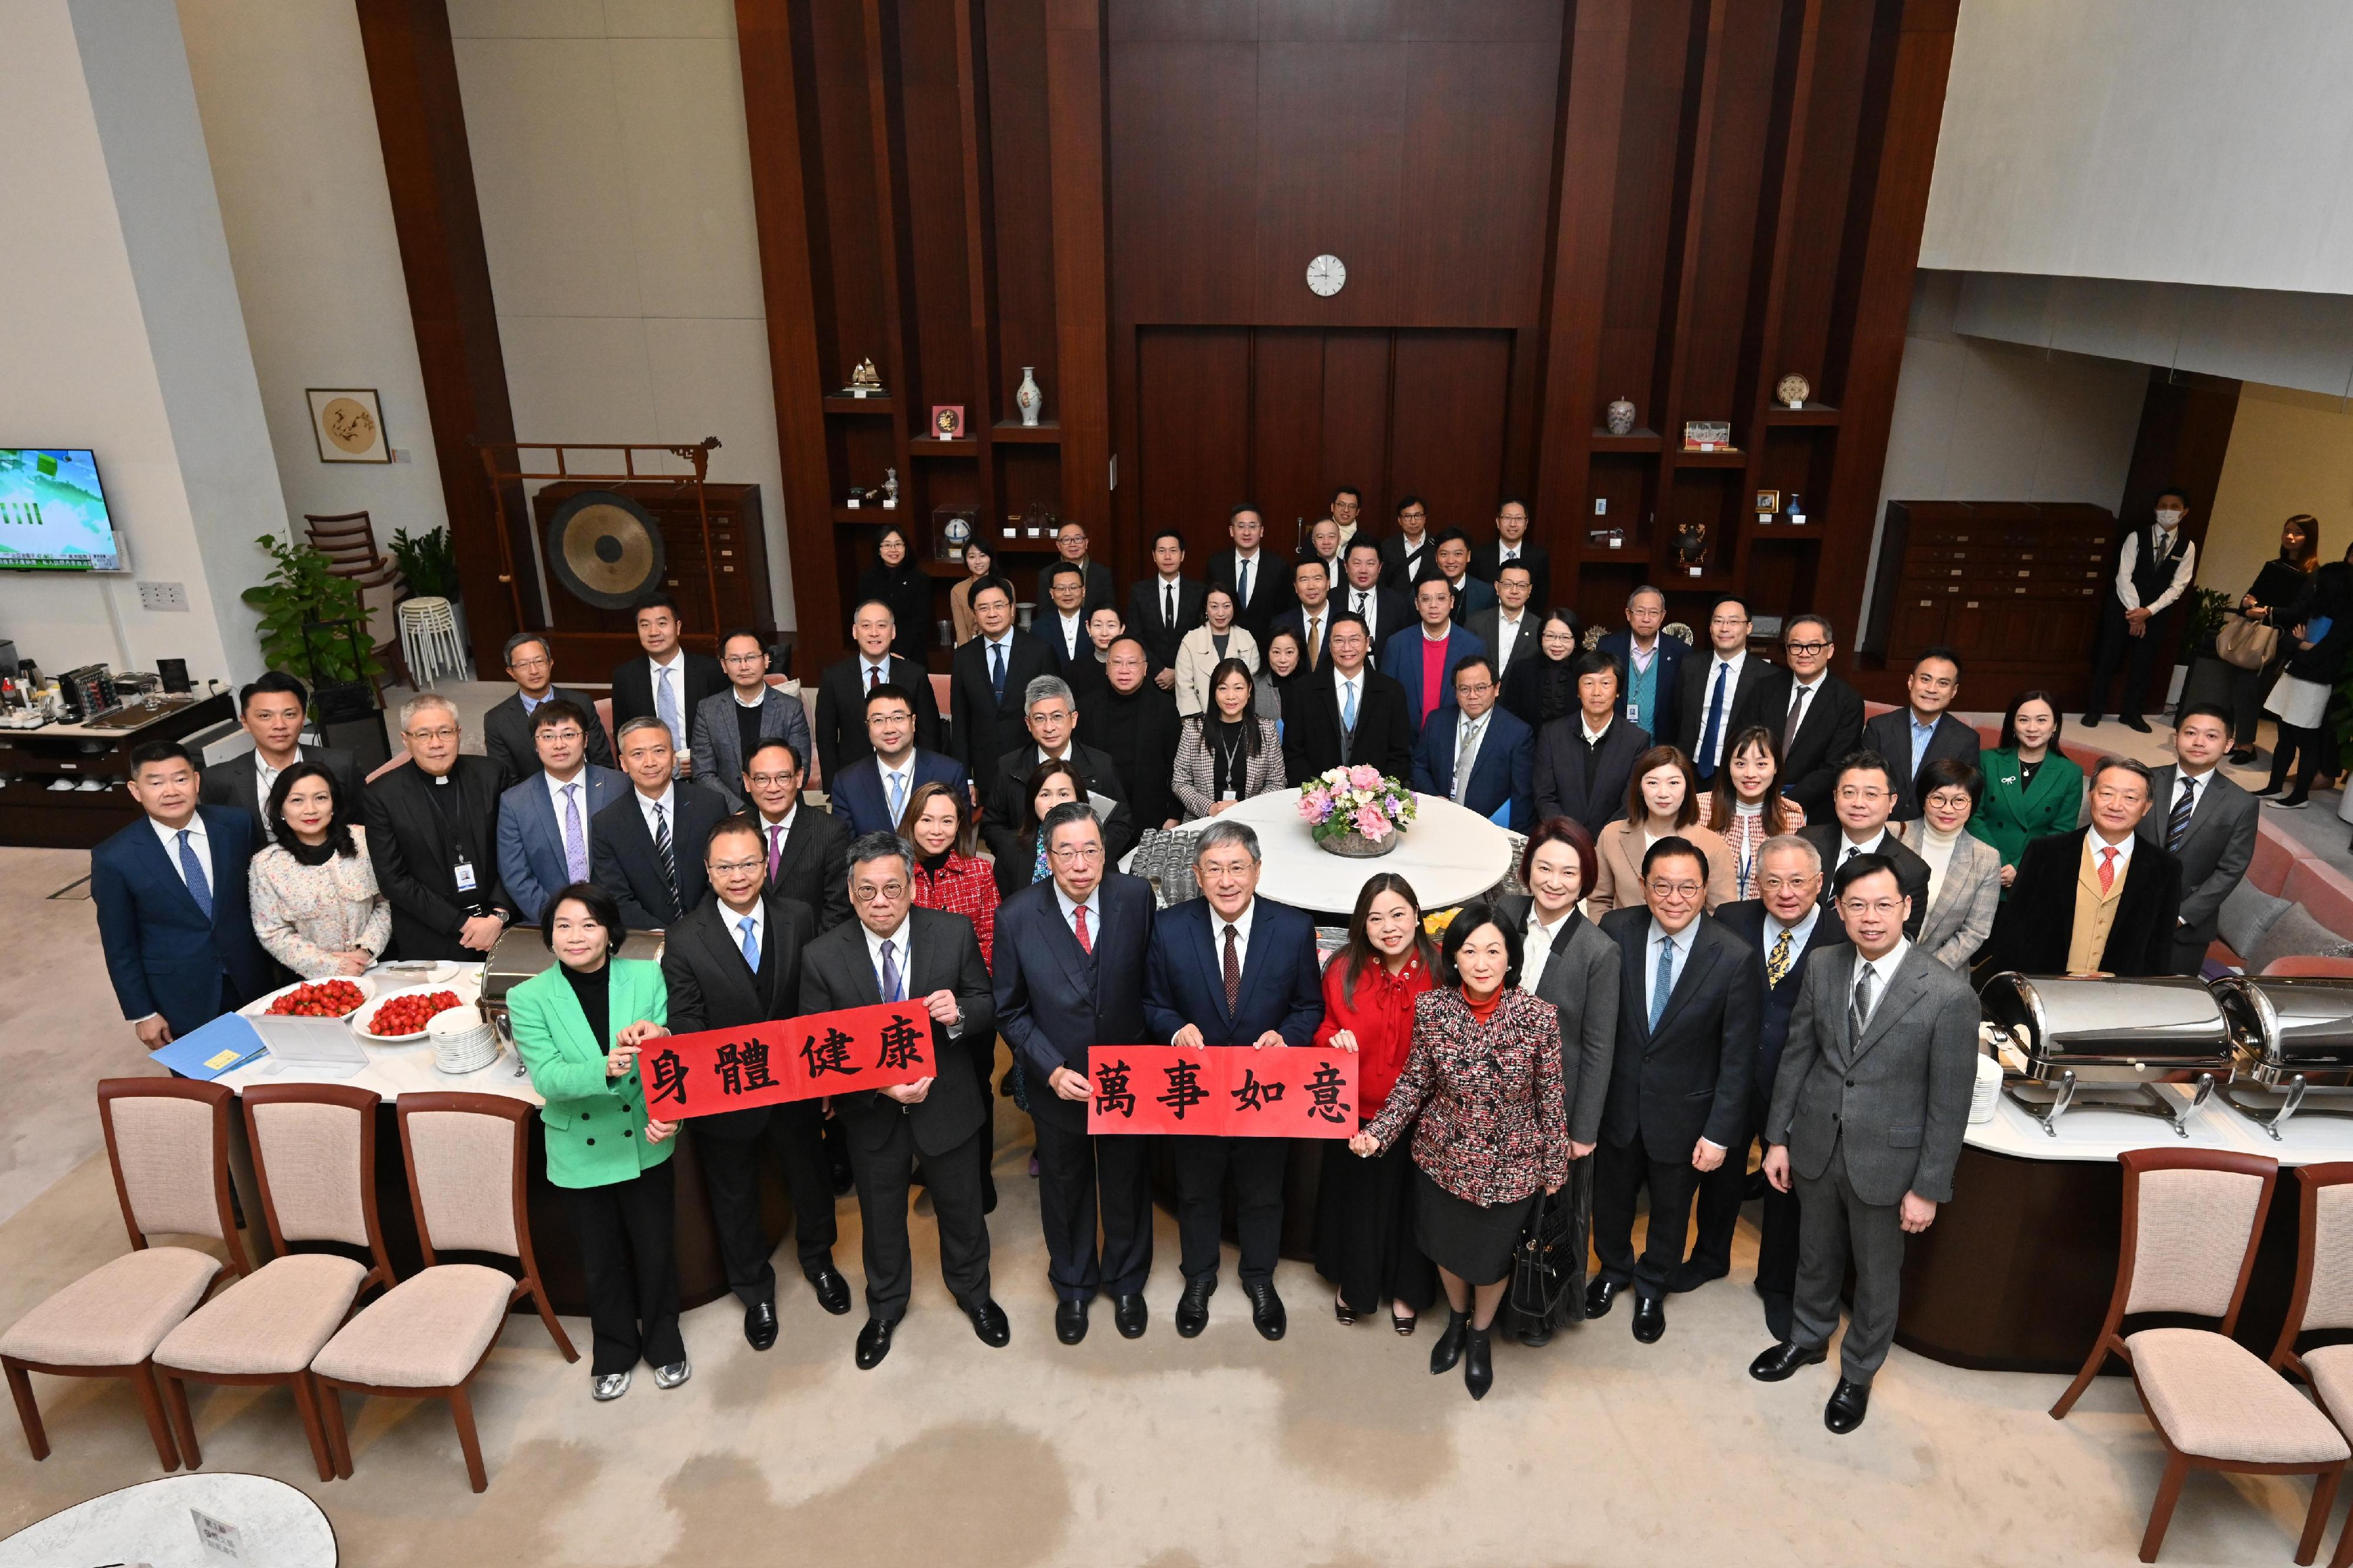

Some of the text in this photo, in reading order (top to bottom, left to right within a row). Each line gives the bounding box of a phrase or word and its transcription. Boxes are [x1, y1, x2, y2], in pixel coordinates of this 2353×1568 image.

[651, 1015, 924, 1105] 身體健康
[1095, 1059, 1351, 1123] 萬事如意
